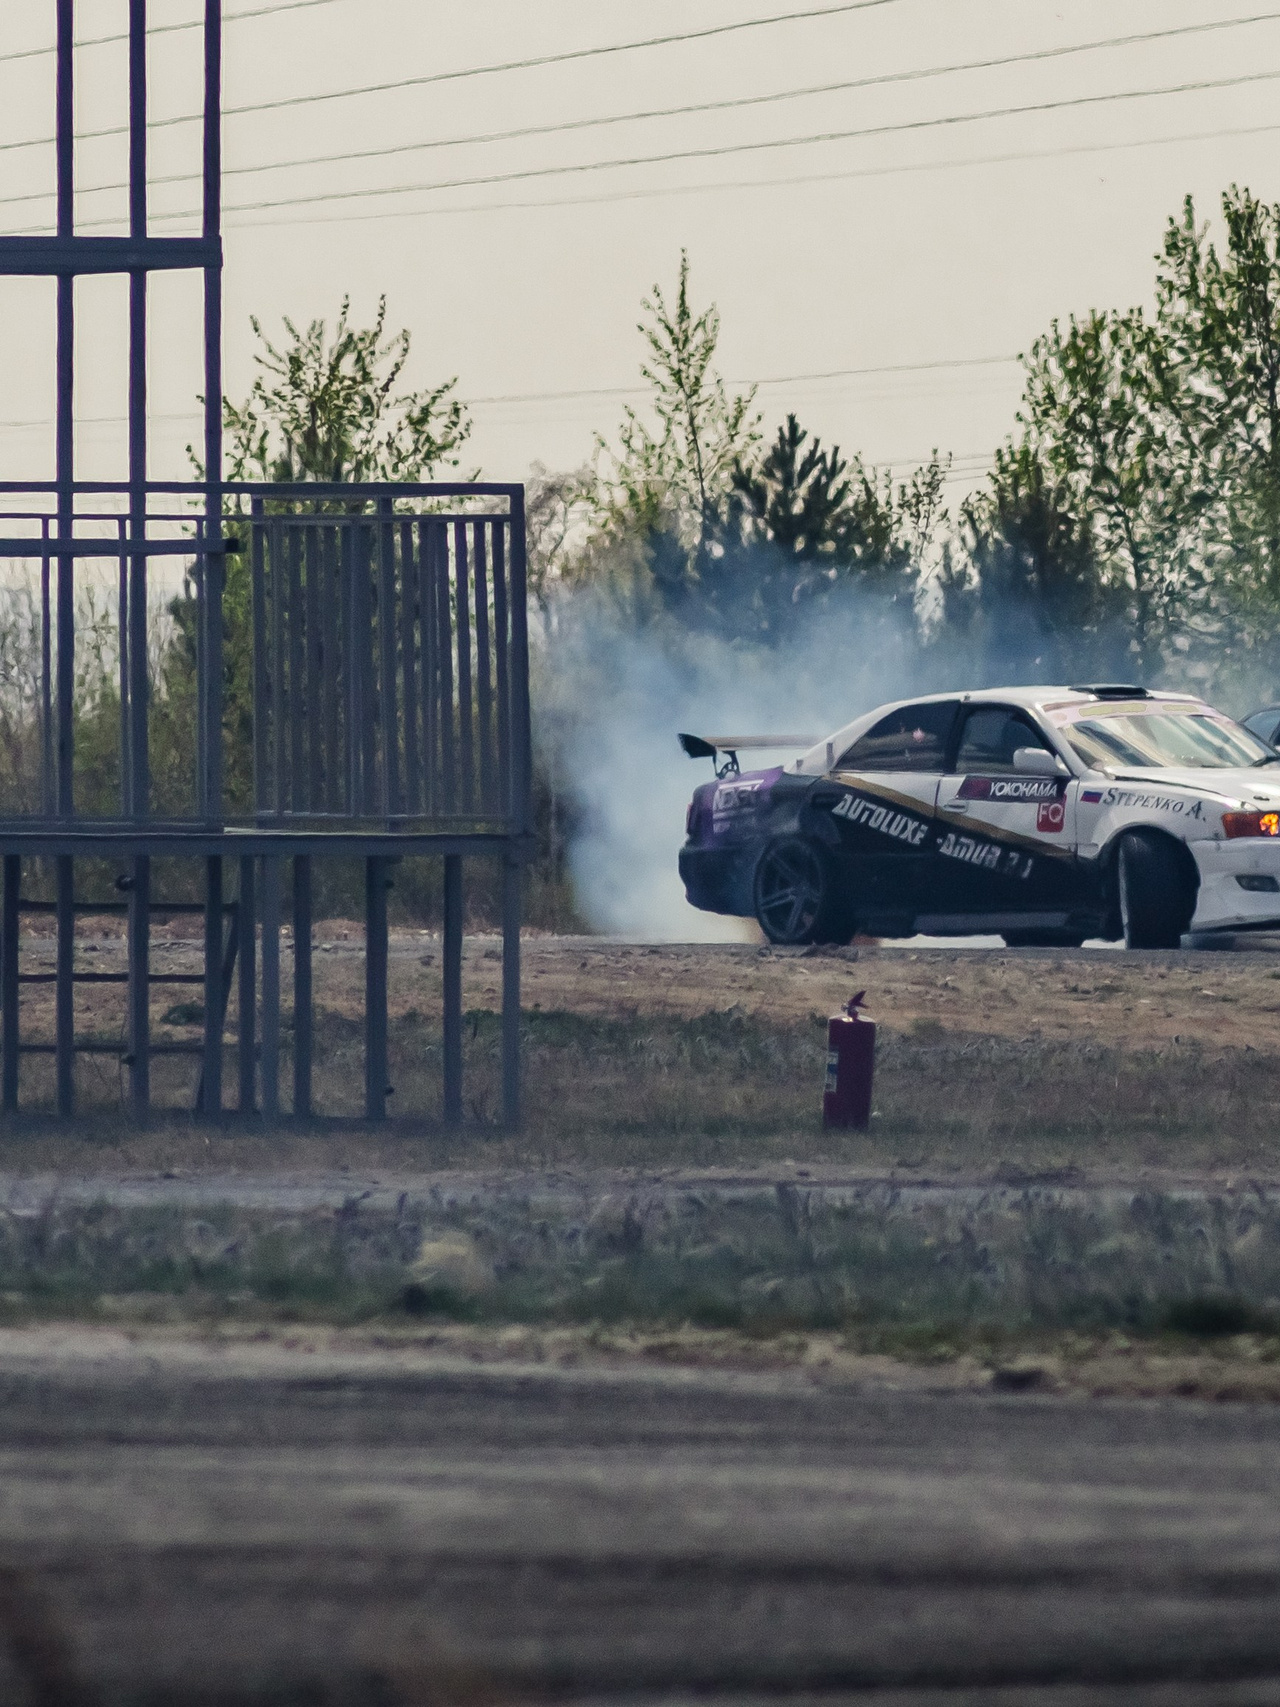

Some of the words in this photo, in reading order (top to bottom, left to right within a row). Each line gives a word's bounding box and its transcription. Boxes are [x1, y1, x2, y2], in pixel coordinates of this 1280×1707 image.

[989, 782, 1058, 797] YOKOHAMA
[1103, 787, 1185, 812] STEPENKO
[1185, 800, 1207, 822] A.
[831, 793, 929, 845] AUTOLUXE
